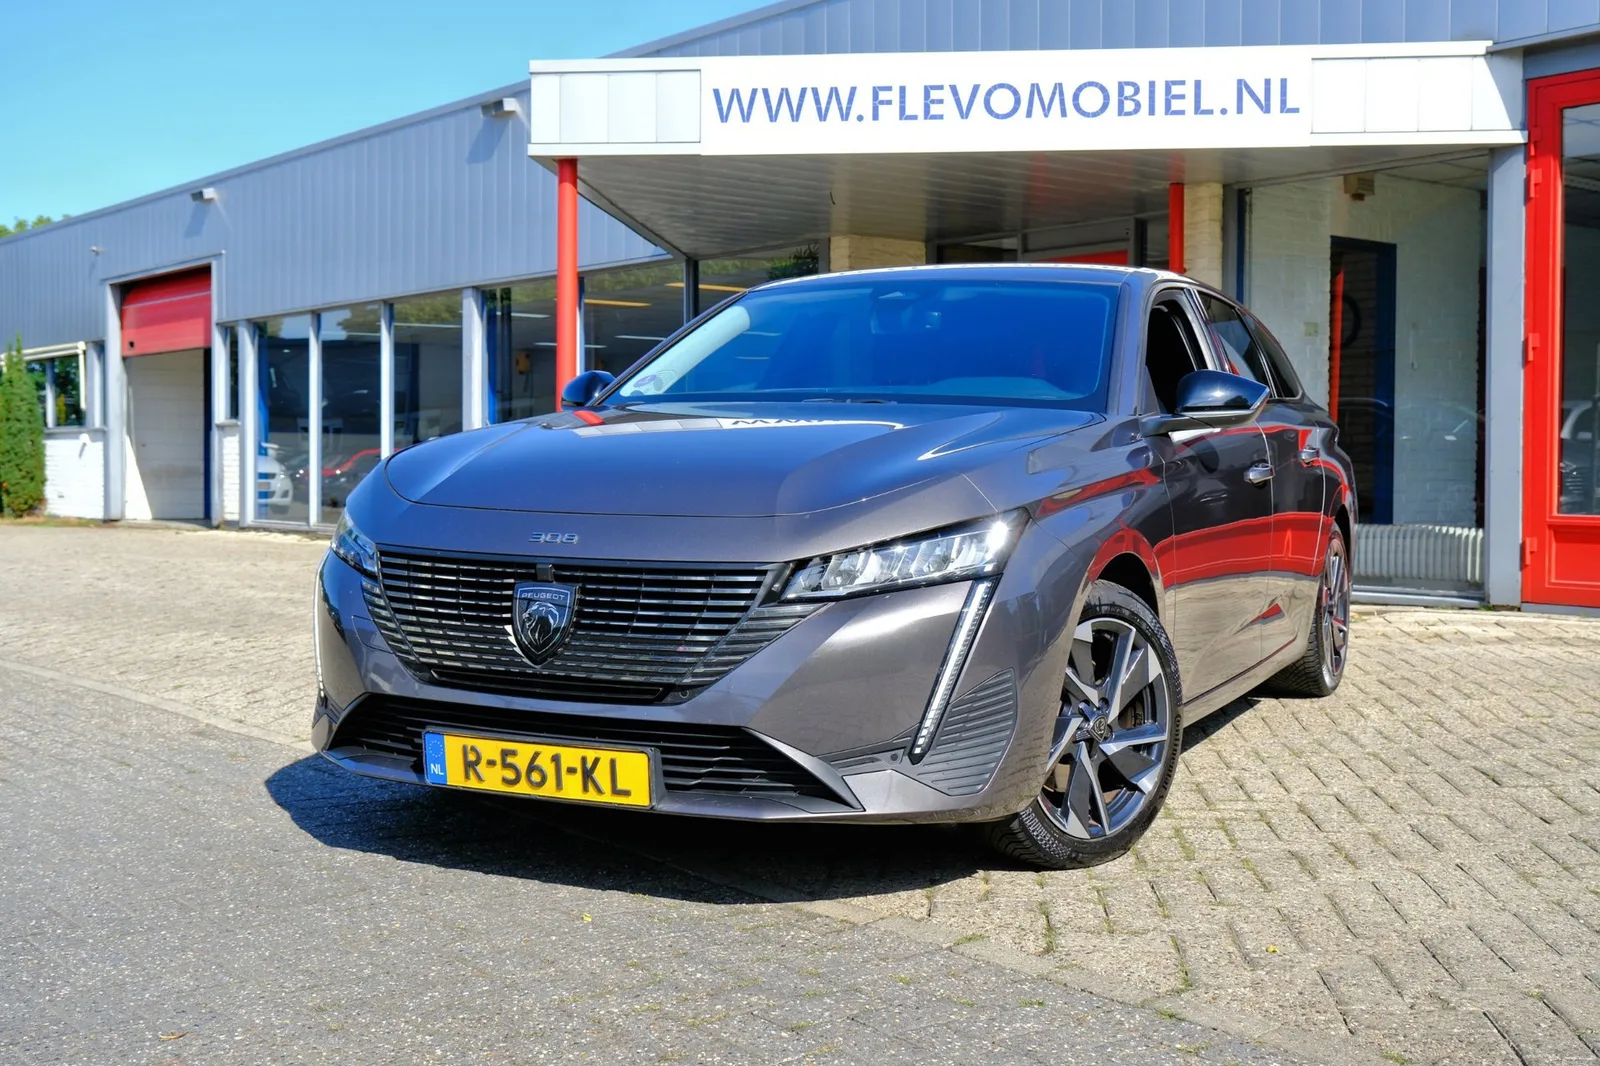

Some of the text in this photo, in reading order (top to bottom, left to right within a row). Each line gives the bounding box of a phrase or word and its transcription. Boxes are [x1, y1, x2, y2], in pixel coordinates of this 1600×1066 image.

[712, 77, 1301, 124] WWW.FLEVOMOBIEL.NL
[529, 531, 580, 545] 308
[521, 592, 565, 601] PEUGEOT
[430, 763, 445, 775] NL
[462, 743, 632, 797] R-561-KL
